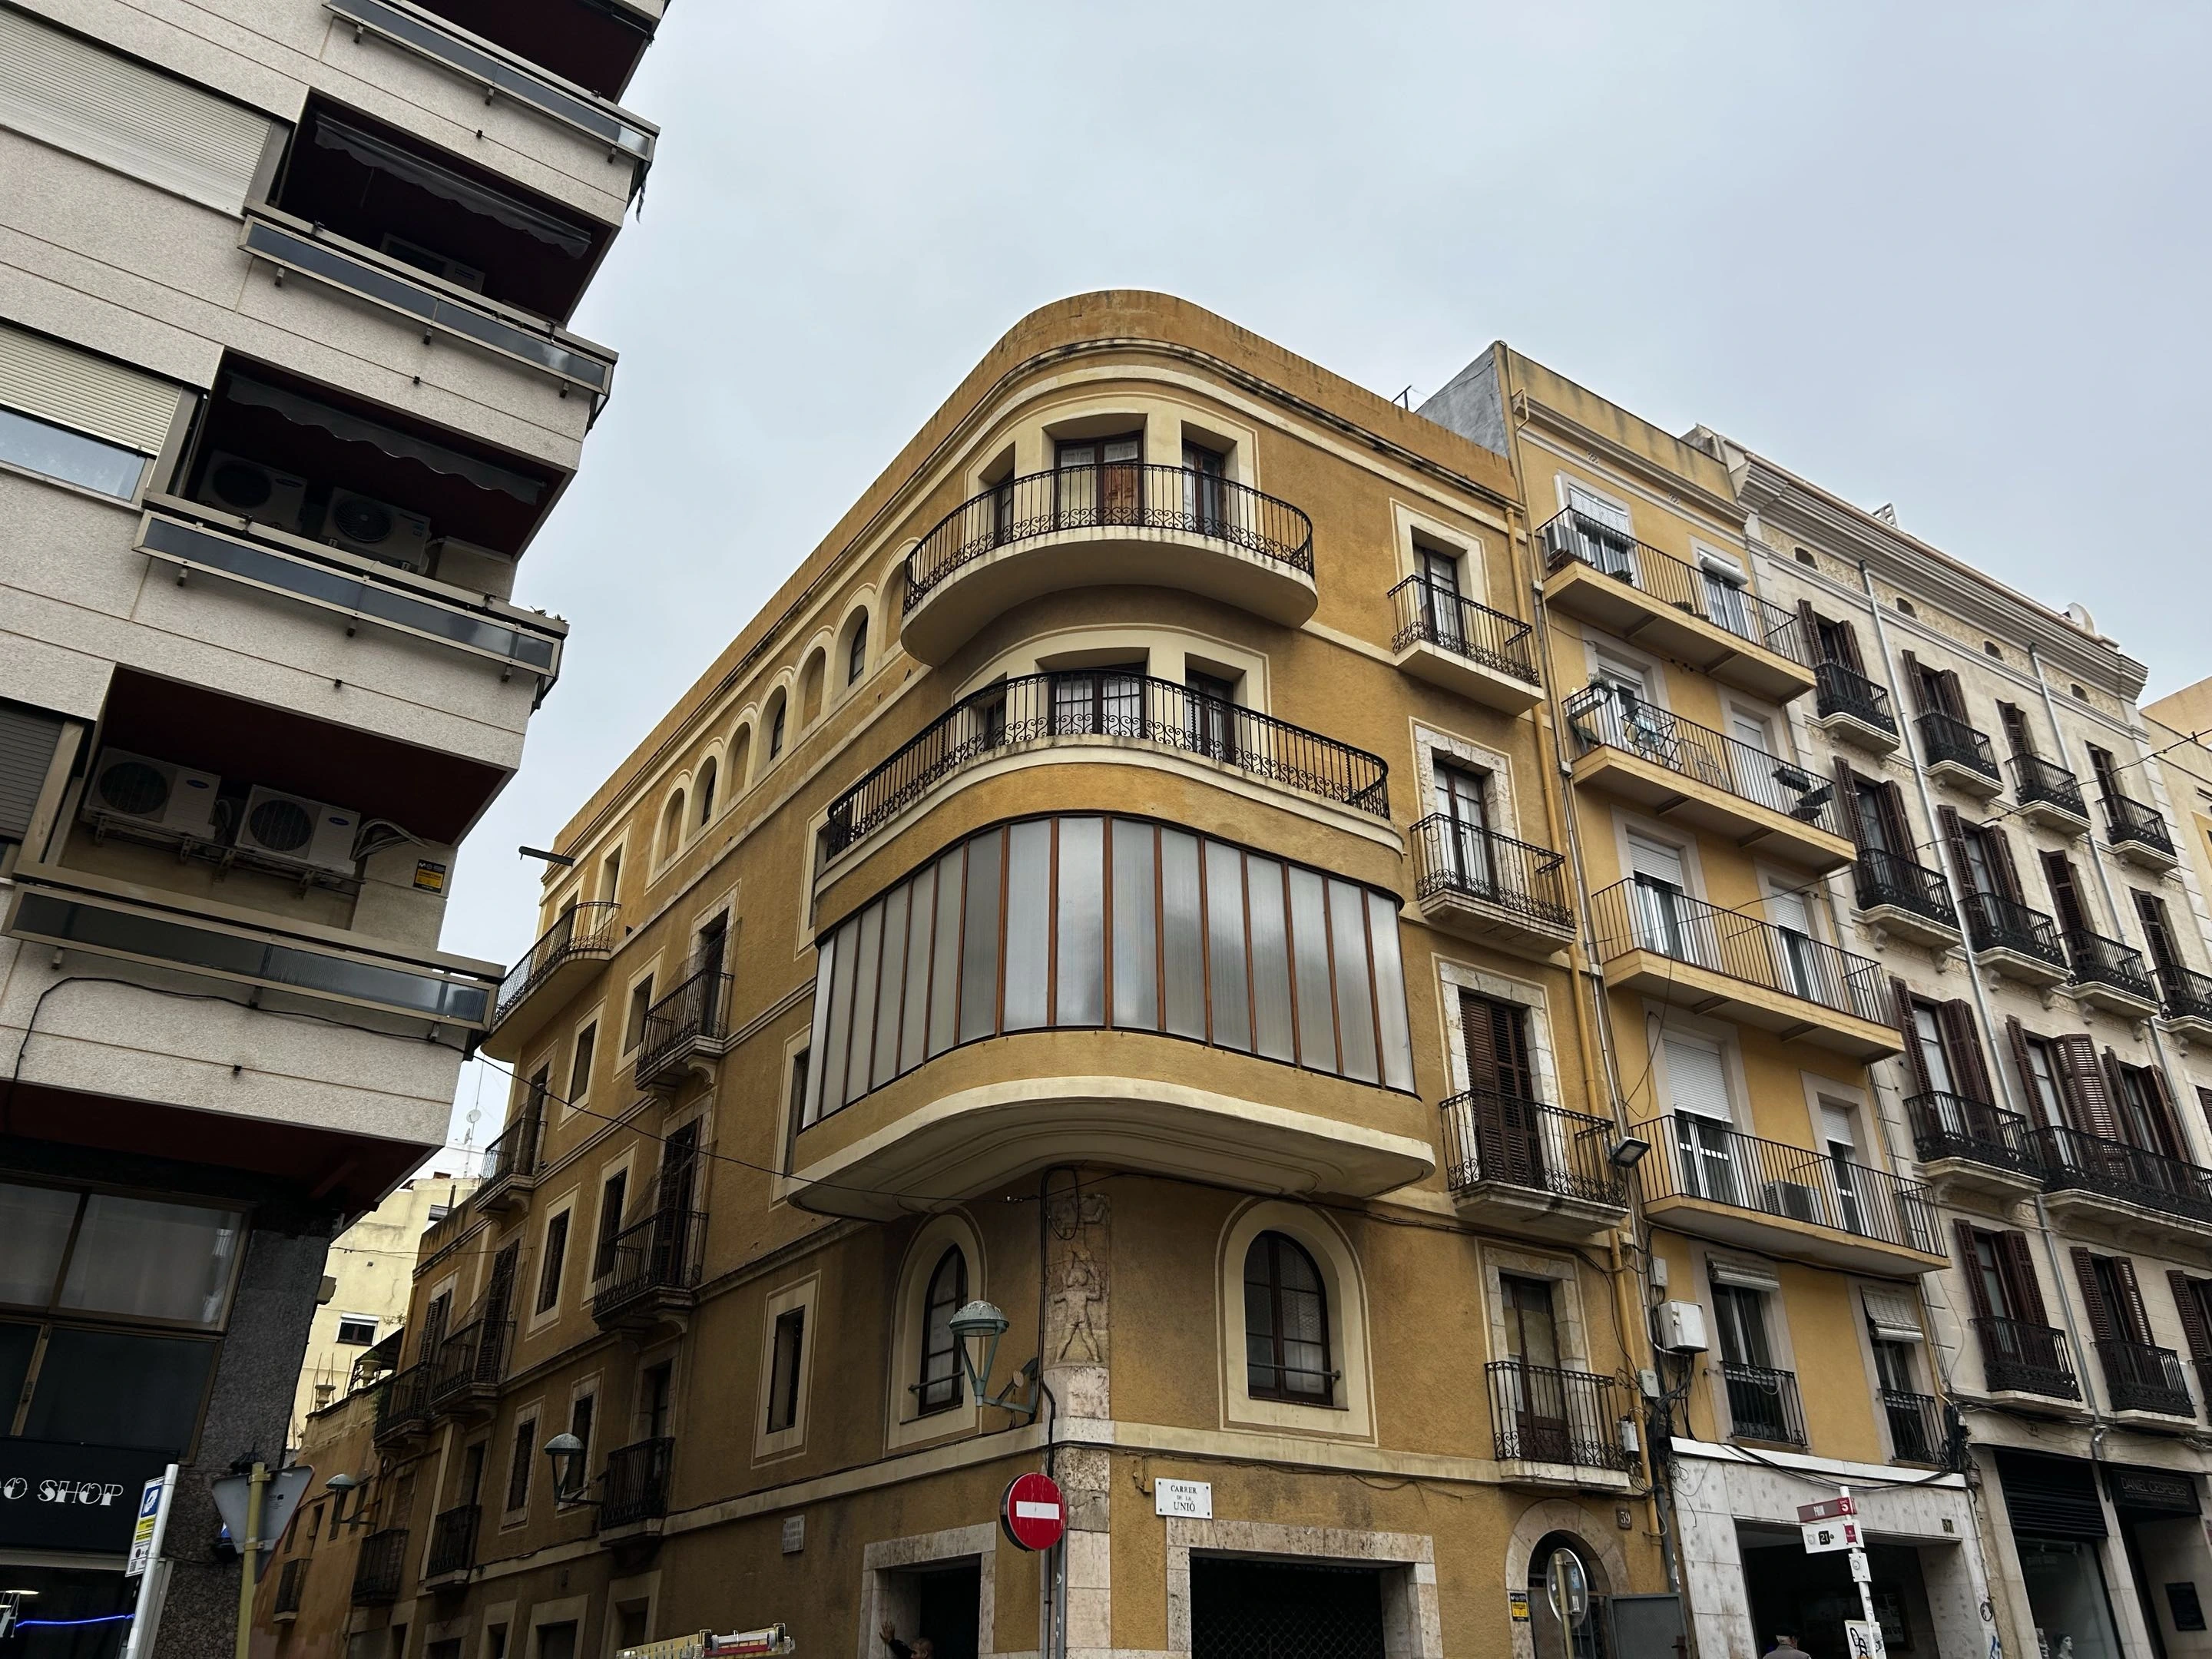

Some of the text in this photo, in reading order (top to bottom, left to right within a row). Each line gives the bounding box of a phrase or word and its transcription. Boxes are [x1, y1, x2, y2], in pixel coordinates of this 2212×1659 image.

[0, 1478, 124, 1505] O SHOP
[1171, 1485, 1197, 1494] CARRER
[1174, 1501, 1196, 1512] UNIÓ
[1621, 1512, 1631, 1524] 39
[1820, 1533, 1829, 1542] 21
